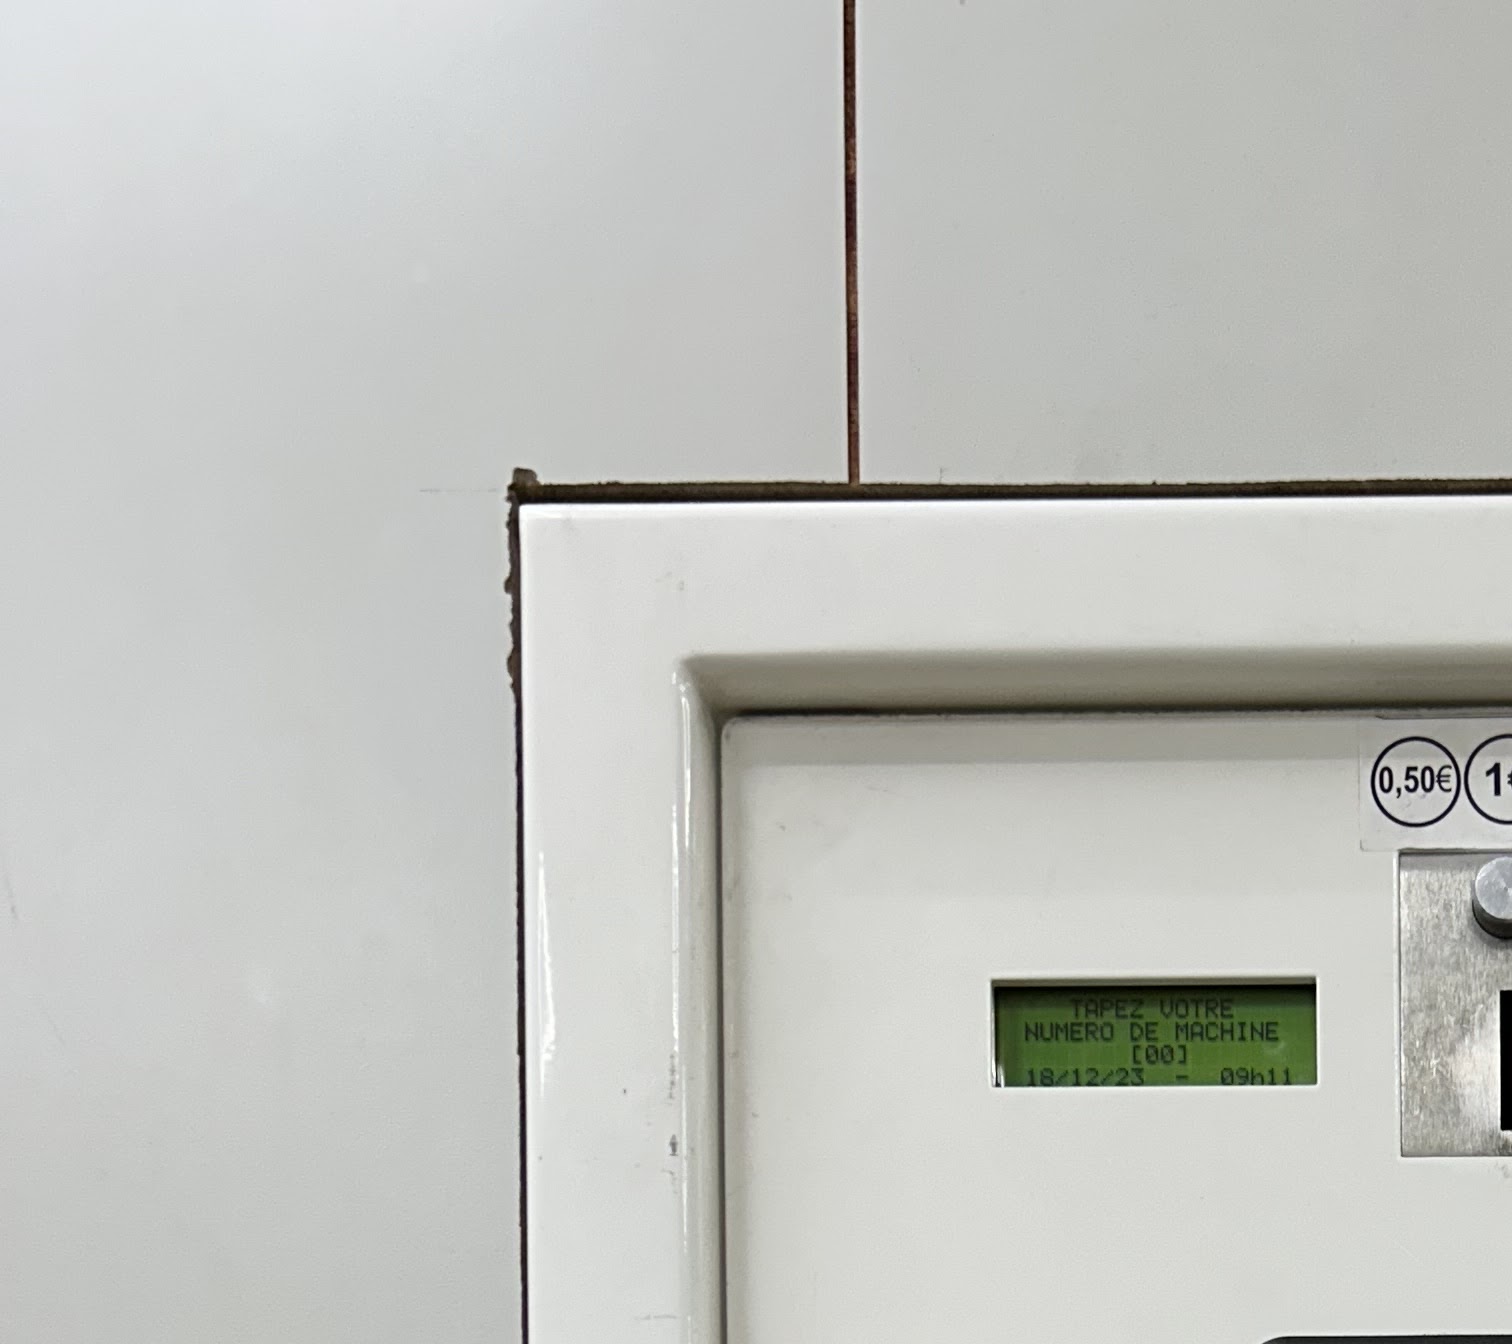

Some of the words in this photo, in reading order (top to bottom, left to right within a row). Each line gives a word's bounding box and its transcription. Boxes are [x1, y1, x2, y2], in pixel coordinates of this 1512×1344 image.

[1378, 765, 1453, 799] 0,50€
[1071, 999, 1145, 1019] TAPEZ
[1159, 998, 1234, 1019] VOTRE
[1024, 1022, 1115, 1042] NUMERO
[1130, 1022, 1159, 1042] DE
[1175, 1021, 1280, 1041] MACHINE
[1132, 1045, 1188, 1066] [00]
[1027, 1067, 1145, 1086] 18/12/23
[1220, 1067, 1293, 1086] 09h11
